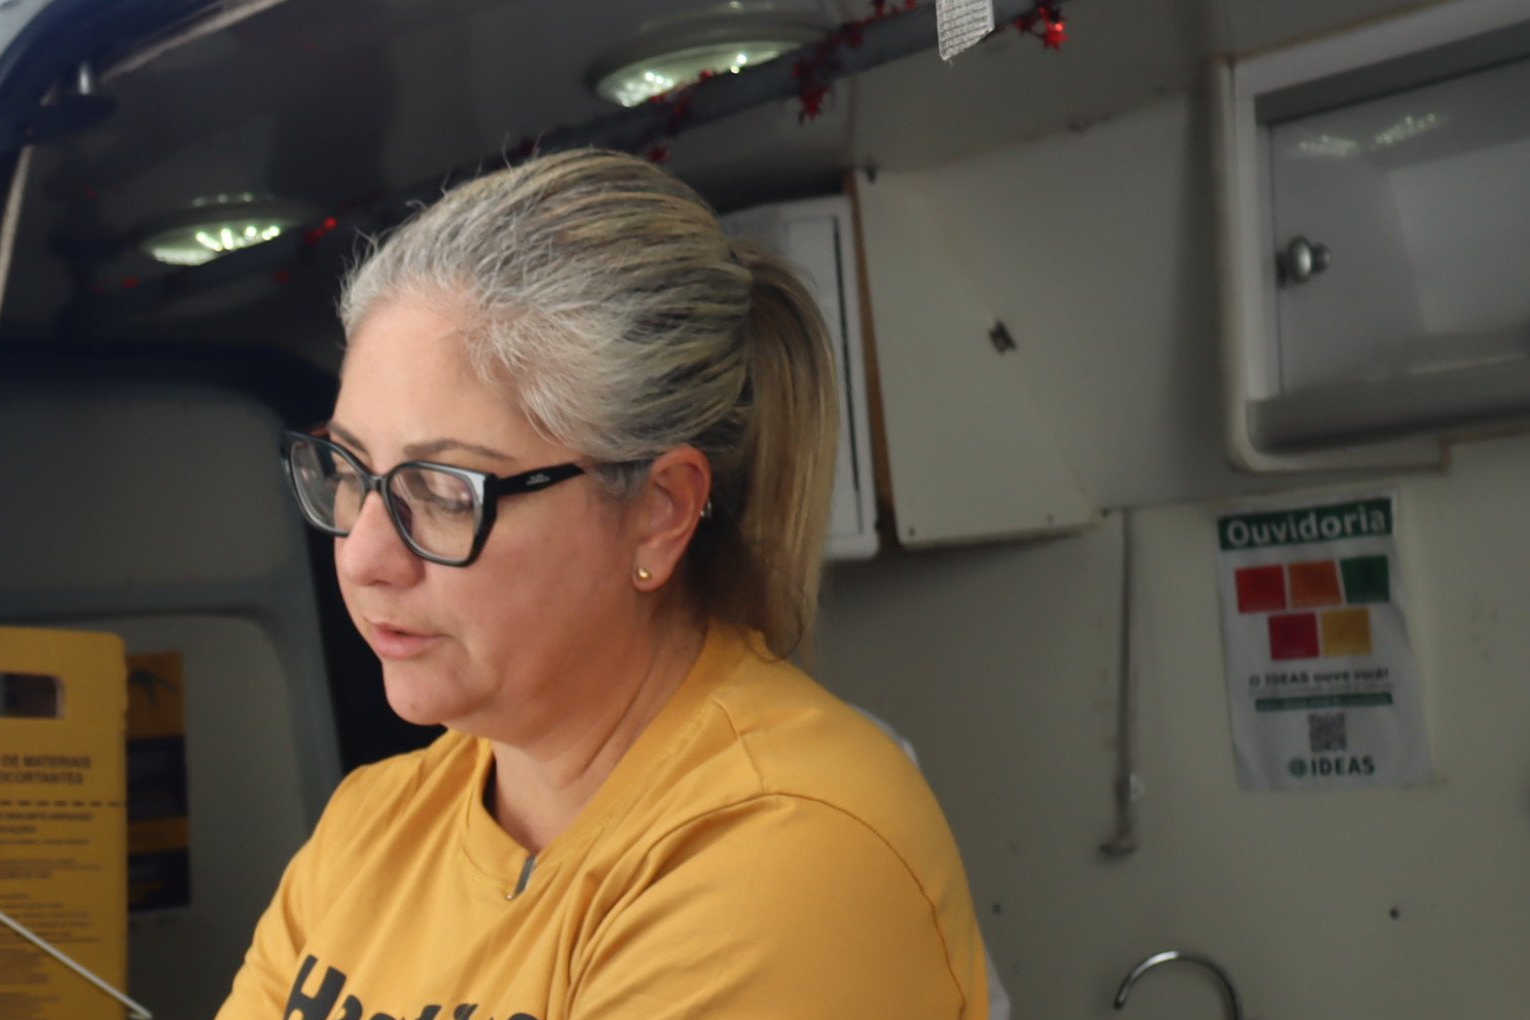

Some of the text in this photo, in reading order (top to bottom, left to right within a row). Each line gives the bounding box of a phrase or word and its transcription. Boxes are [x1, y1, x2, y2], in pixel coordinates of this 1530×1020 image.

[1227, 504, 1386, 546] Ouvidoria
[1265, 671, 1309, 686] IDEAS
[1310, 756, 1376, 776] IDEAS
